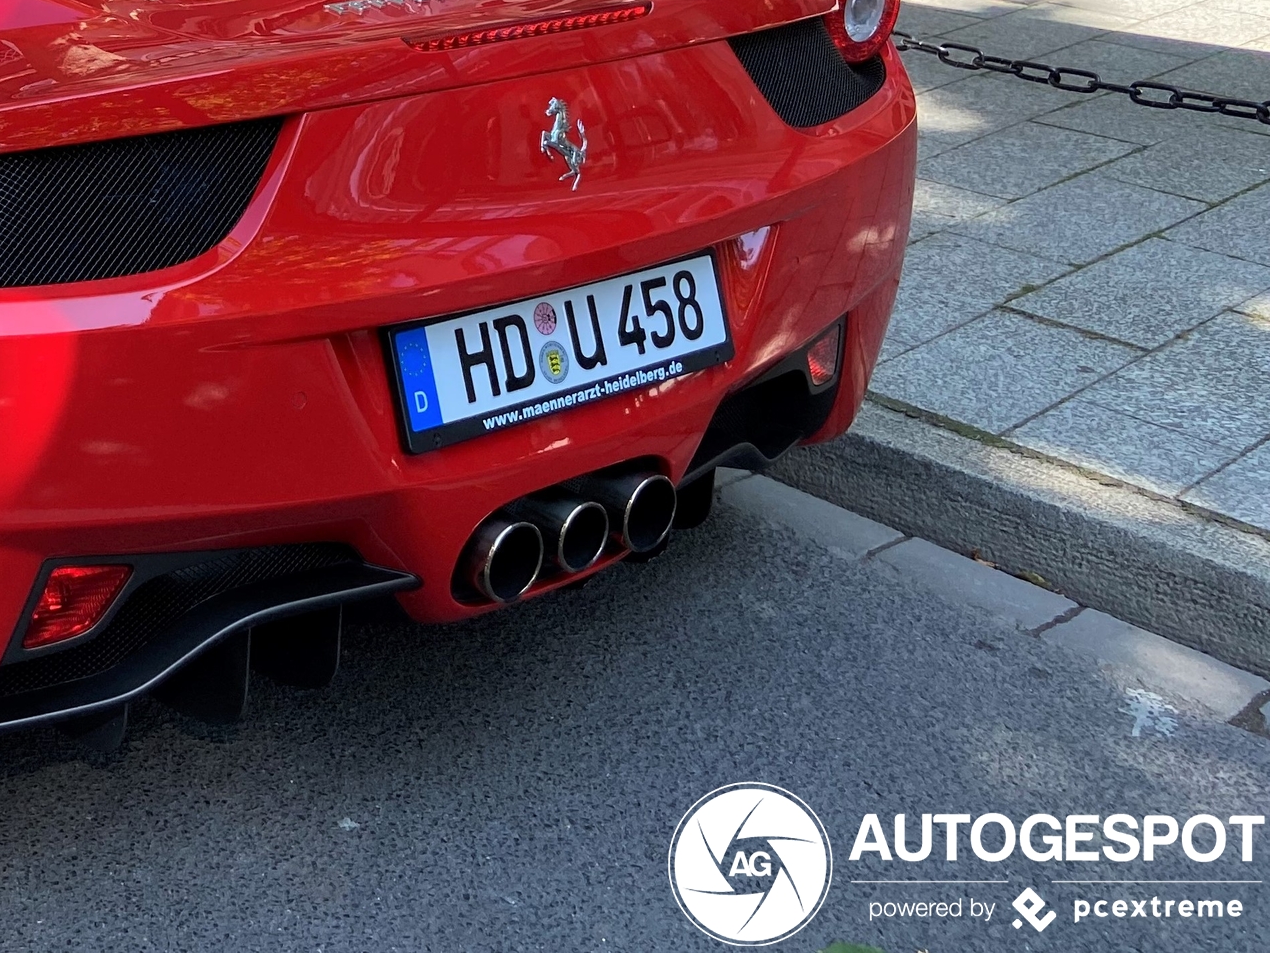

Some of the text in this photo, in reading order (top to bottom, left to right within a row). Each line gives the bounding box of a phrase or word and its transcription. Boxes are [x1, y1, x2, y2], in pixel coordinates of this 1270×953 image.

[454, 313, 537, 404] HD
[563, 294, 608, 371] U
[617, 269, 705, 355] 458
[414, 389, 429, 414] D
[482, 360, 683, 431] www.maennerarzt-heidelberg.de
